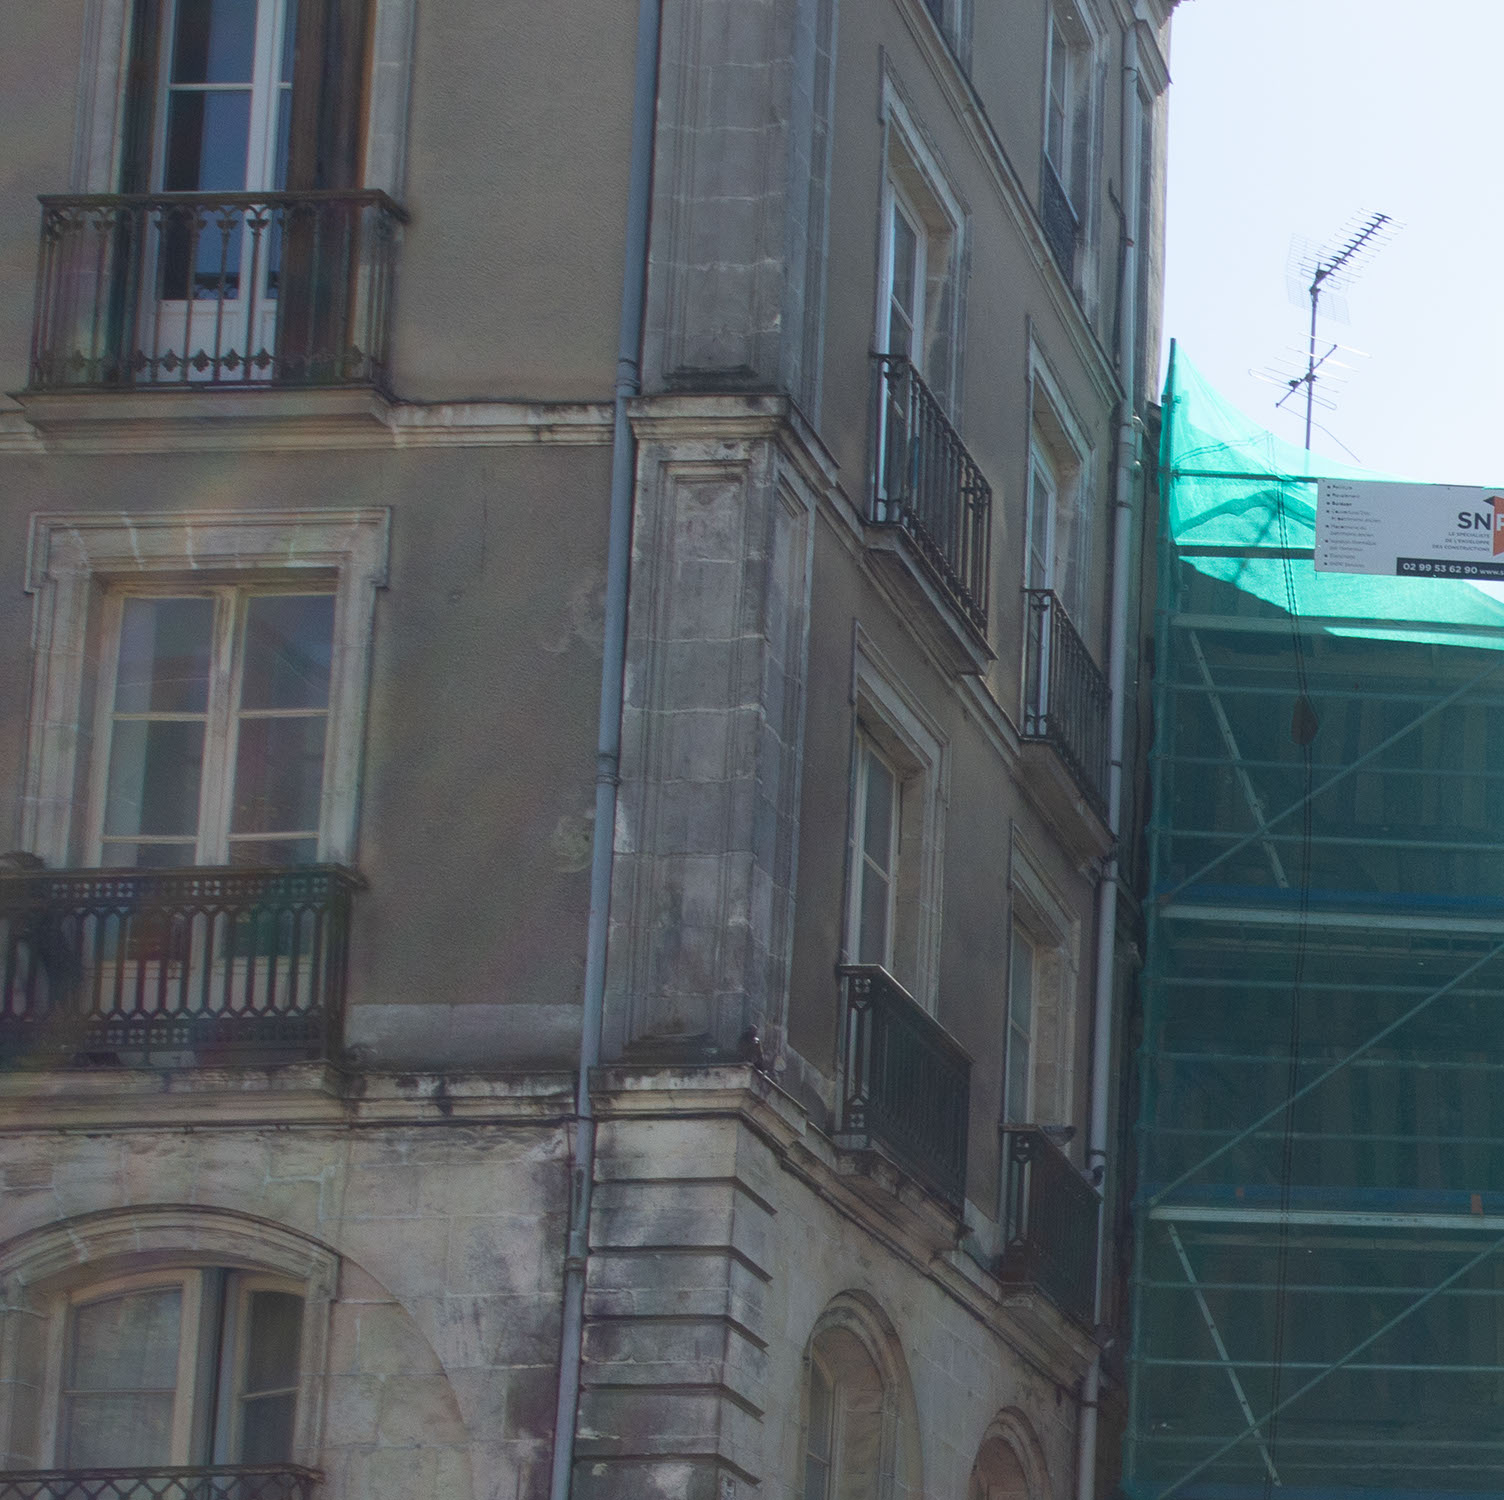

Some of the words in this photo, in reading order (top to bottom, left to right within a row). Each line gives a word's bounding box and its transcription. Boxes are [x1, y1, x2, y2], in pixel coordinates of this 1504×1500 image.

[1403, 562, 1416, 572] 02
[1418, 563, 1432, 572] 99
[1433, 564, 1447, 573] 53
[1449, 565, 1462, 574] 62
[1464, 566, 1478, 575] 90
